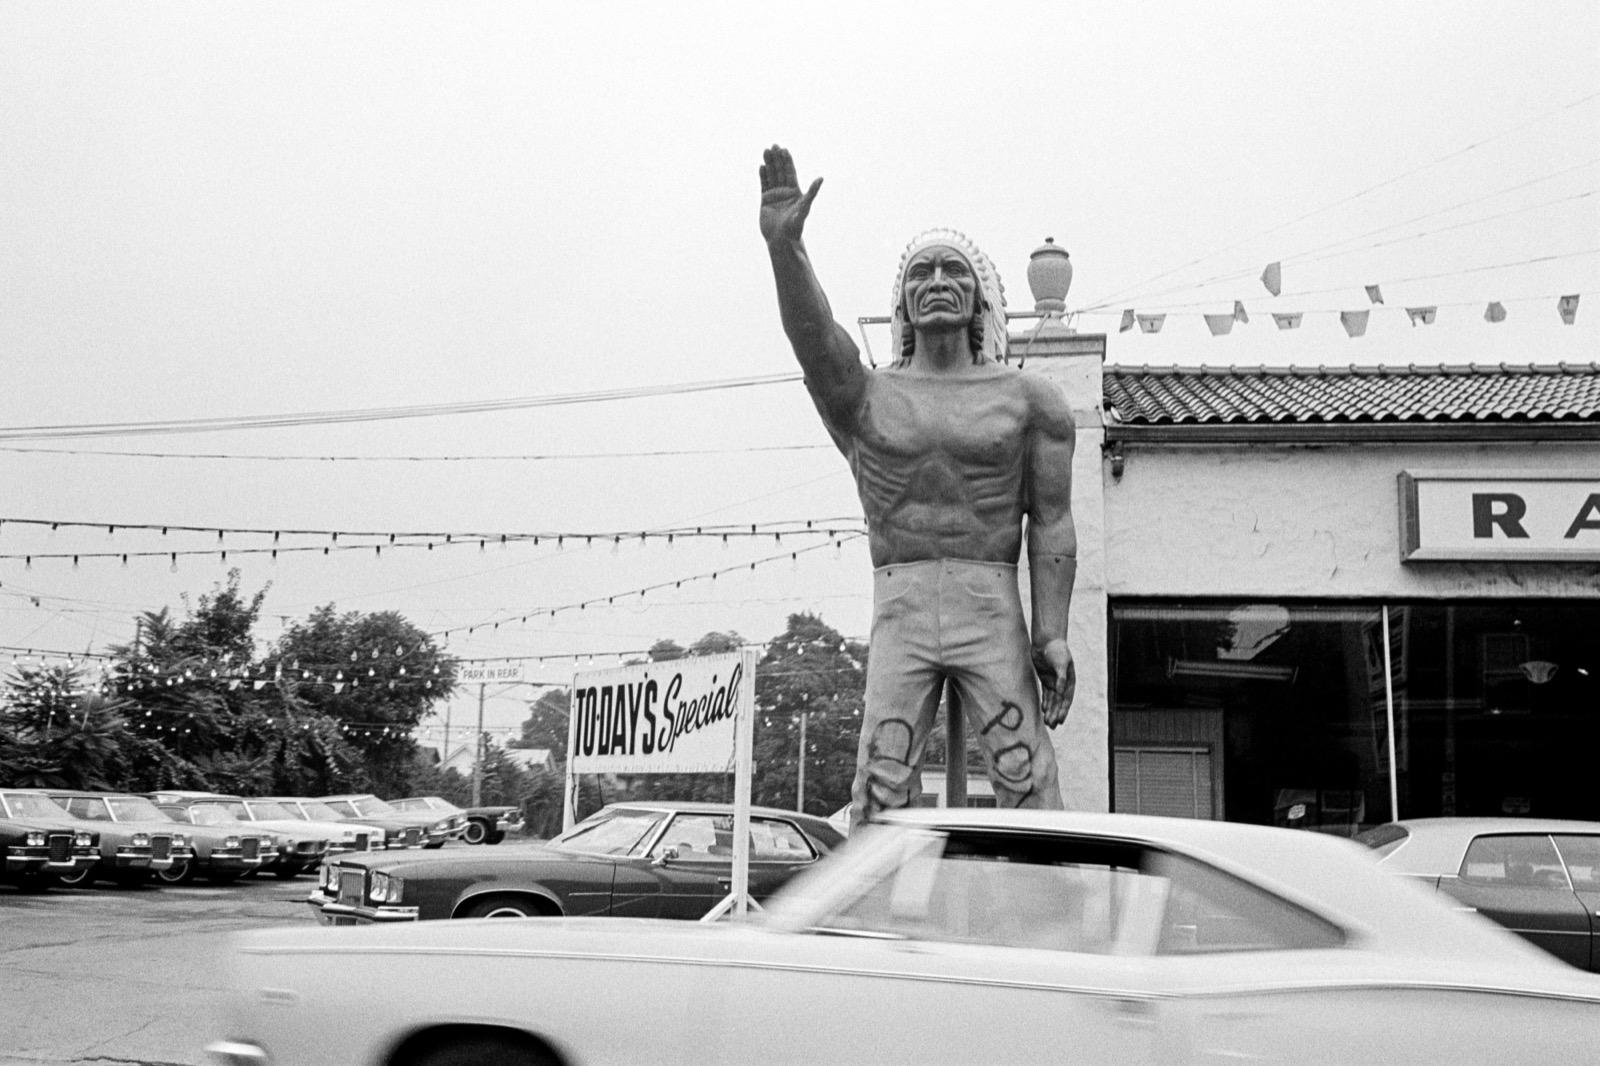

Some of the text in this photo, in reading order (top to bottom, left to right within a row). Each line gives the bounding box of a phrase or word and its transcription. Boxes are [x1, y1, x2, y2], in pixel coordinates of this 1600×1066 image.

[463, 668, 519, 680] PARK IN REAR
[657, 661, 742, 754] Special
